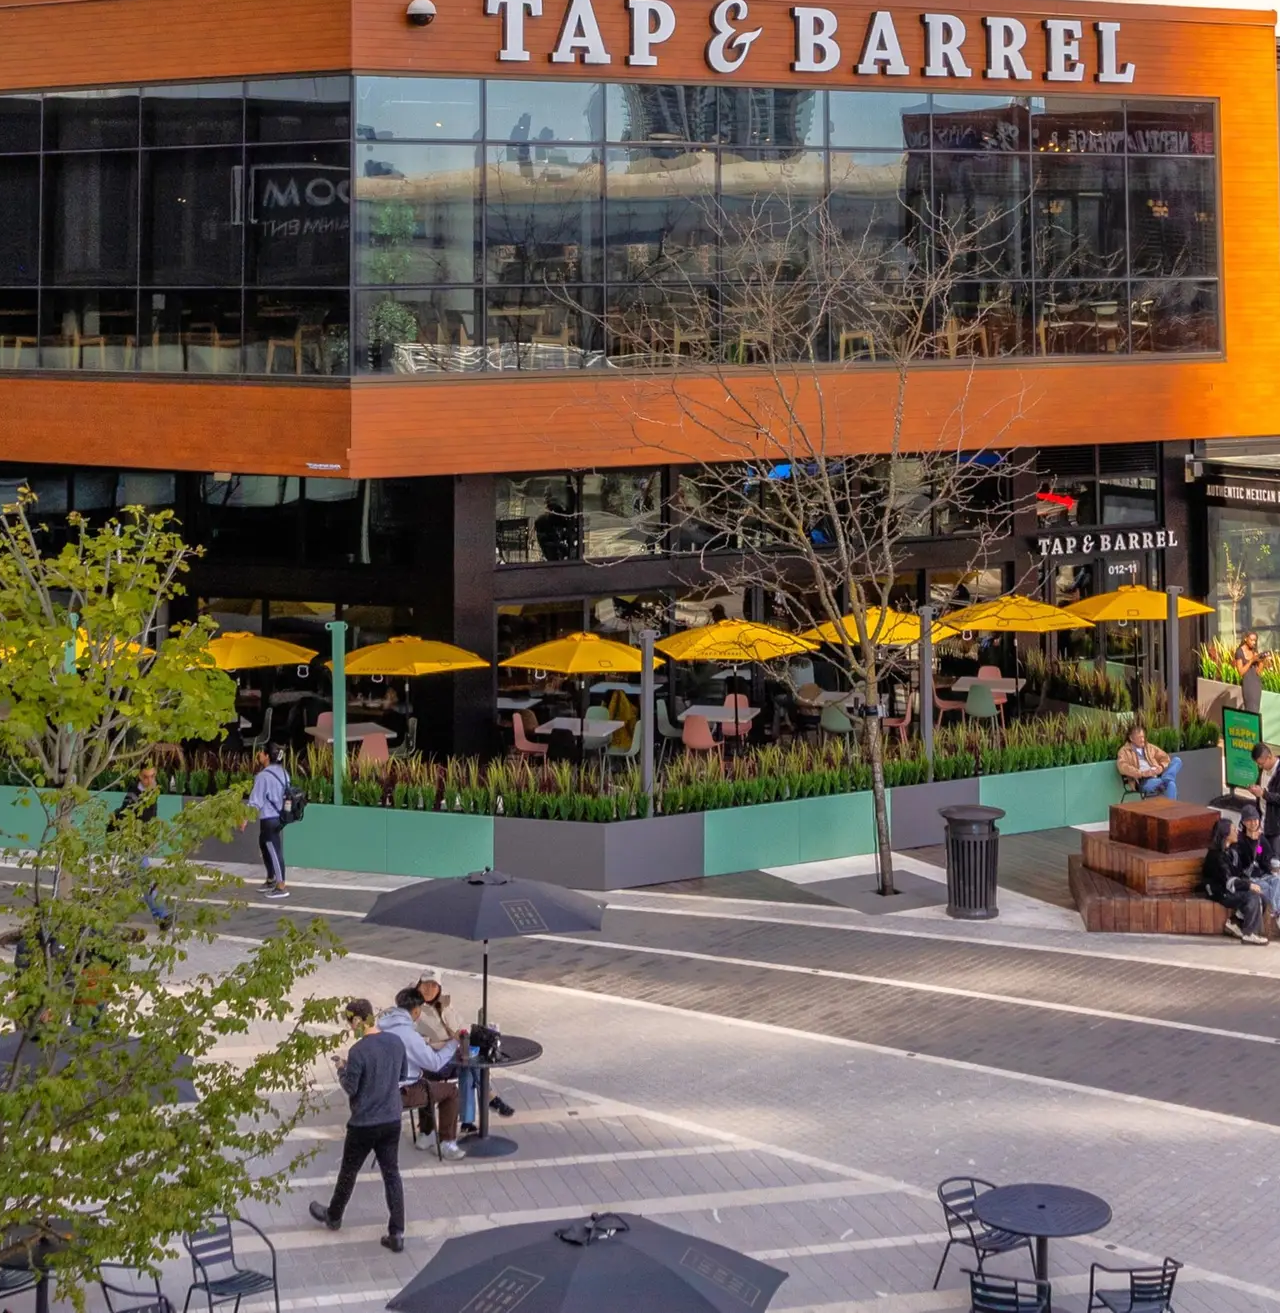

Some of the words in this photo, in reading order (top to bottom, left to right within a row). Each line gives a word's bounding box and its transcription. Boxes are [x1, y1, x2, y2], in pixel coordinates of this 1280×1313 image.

[791, 5, 1136, 84] BARREL
[1206, 484, 1245, 501] AUTHENTIC
[1245, 488, 1276, 503] MEXICAN
[1038, 538, 1077, 556] TAP
[1083, 534, 1095, 554] &
[1100, 530, 1178, 553] BARREL
[1108, 563, 1137, 575] 012-11
[1228, 727, 1257, 741] HAPPY
